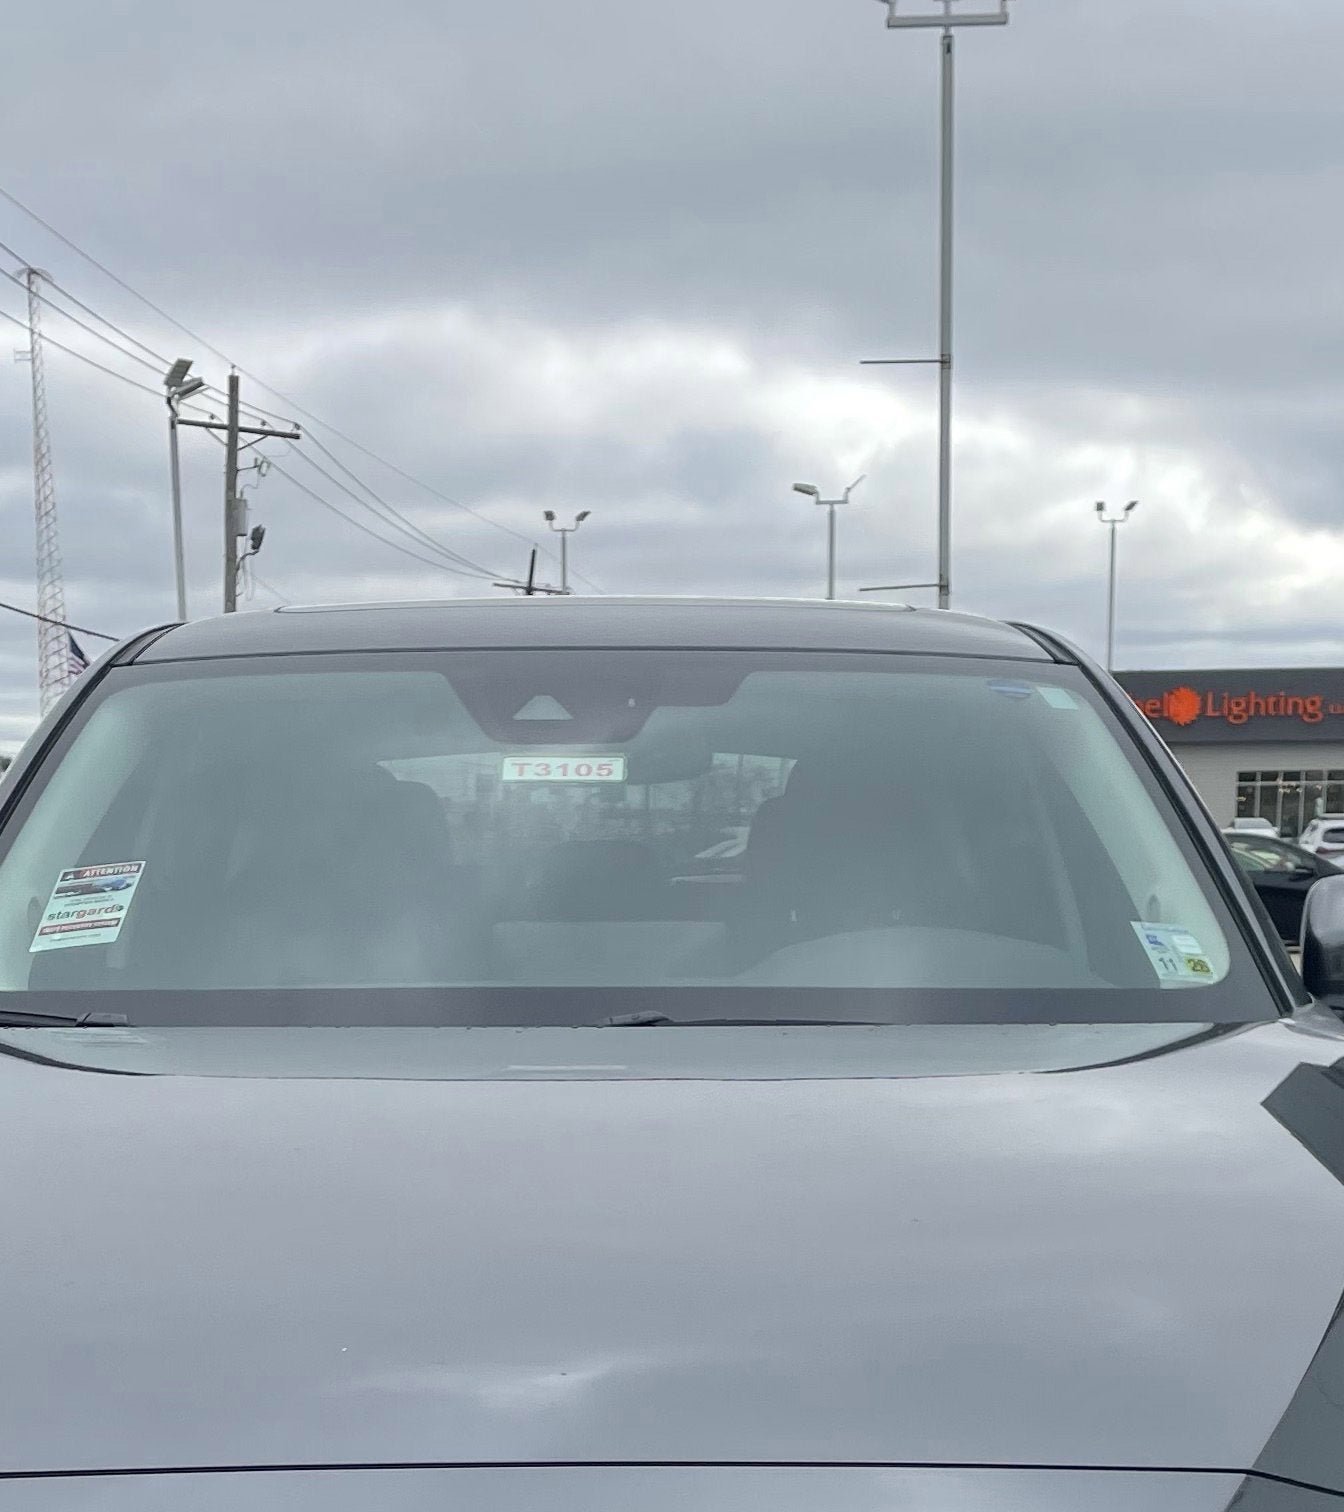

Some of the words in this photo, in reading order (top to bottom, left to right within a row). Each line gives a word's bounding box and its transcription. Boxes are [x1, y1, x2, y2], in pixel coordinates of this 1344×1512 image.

[1206, 691, 1324, 724] Lighting
[511, 763, 613, 777] T3105
[83, 865, 138, 877] ATTENTION
